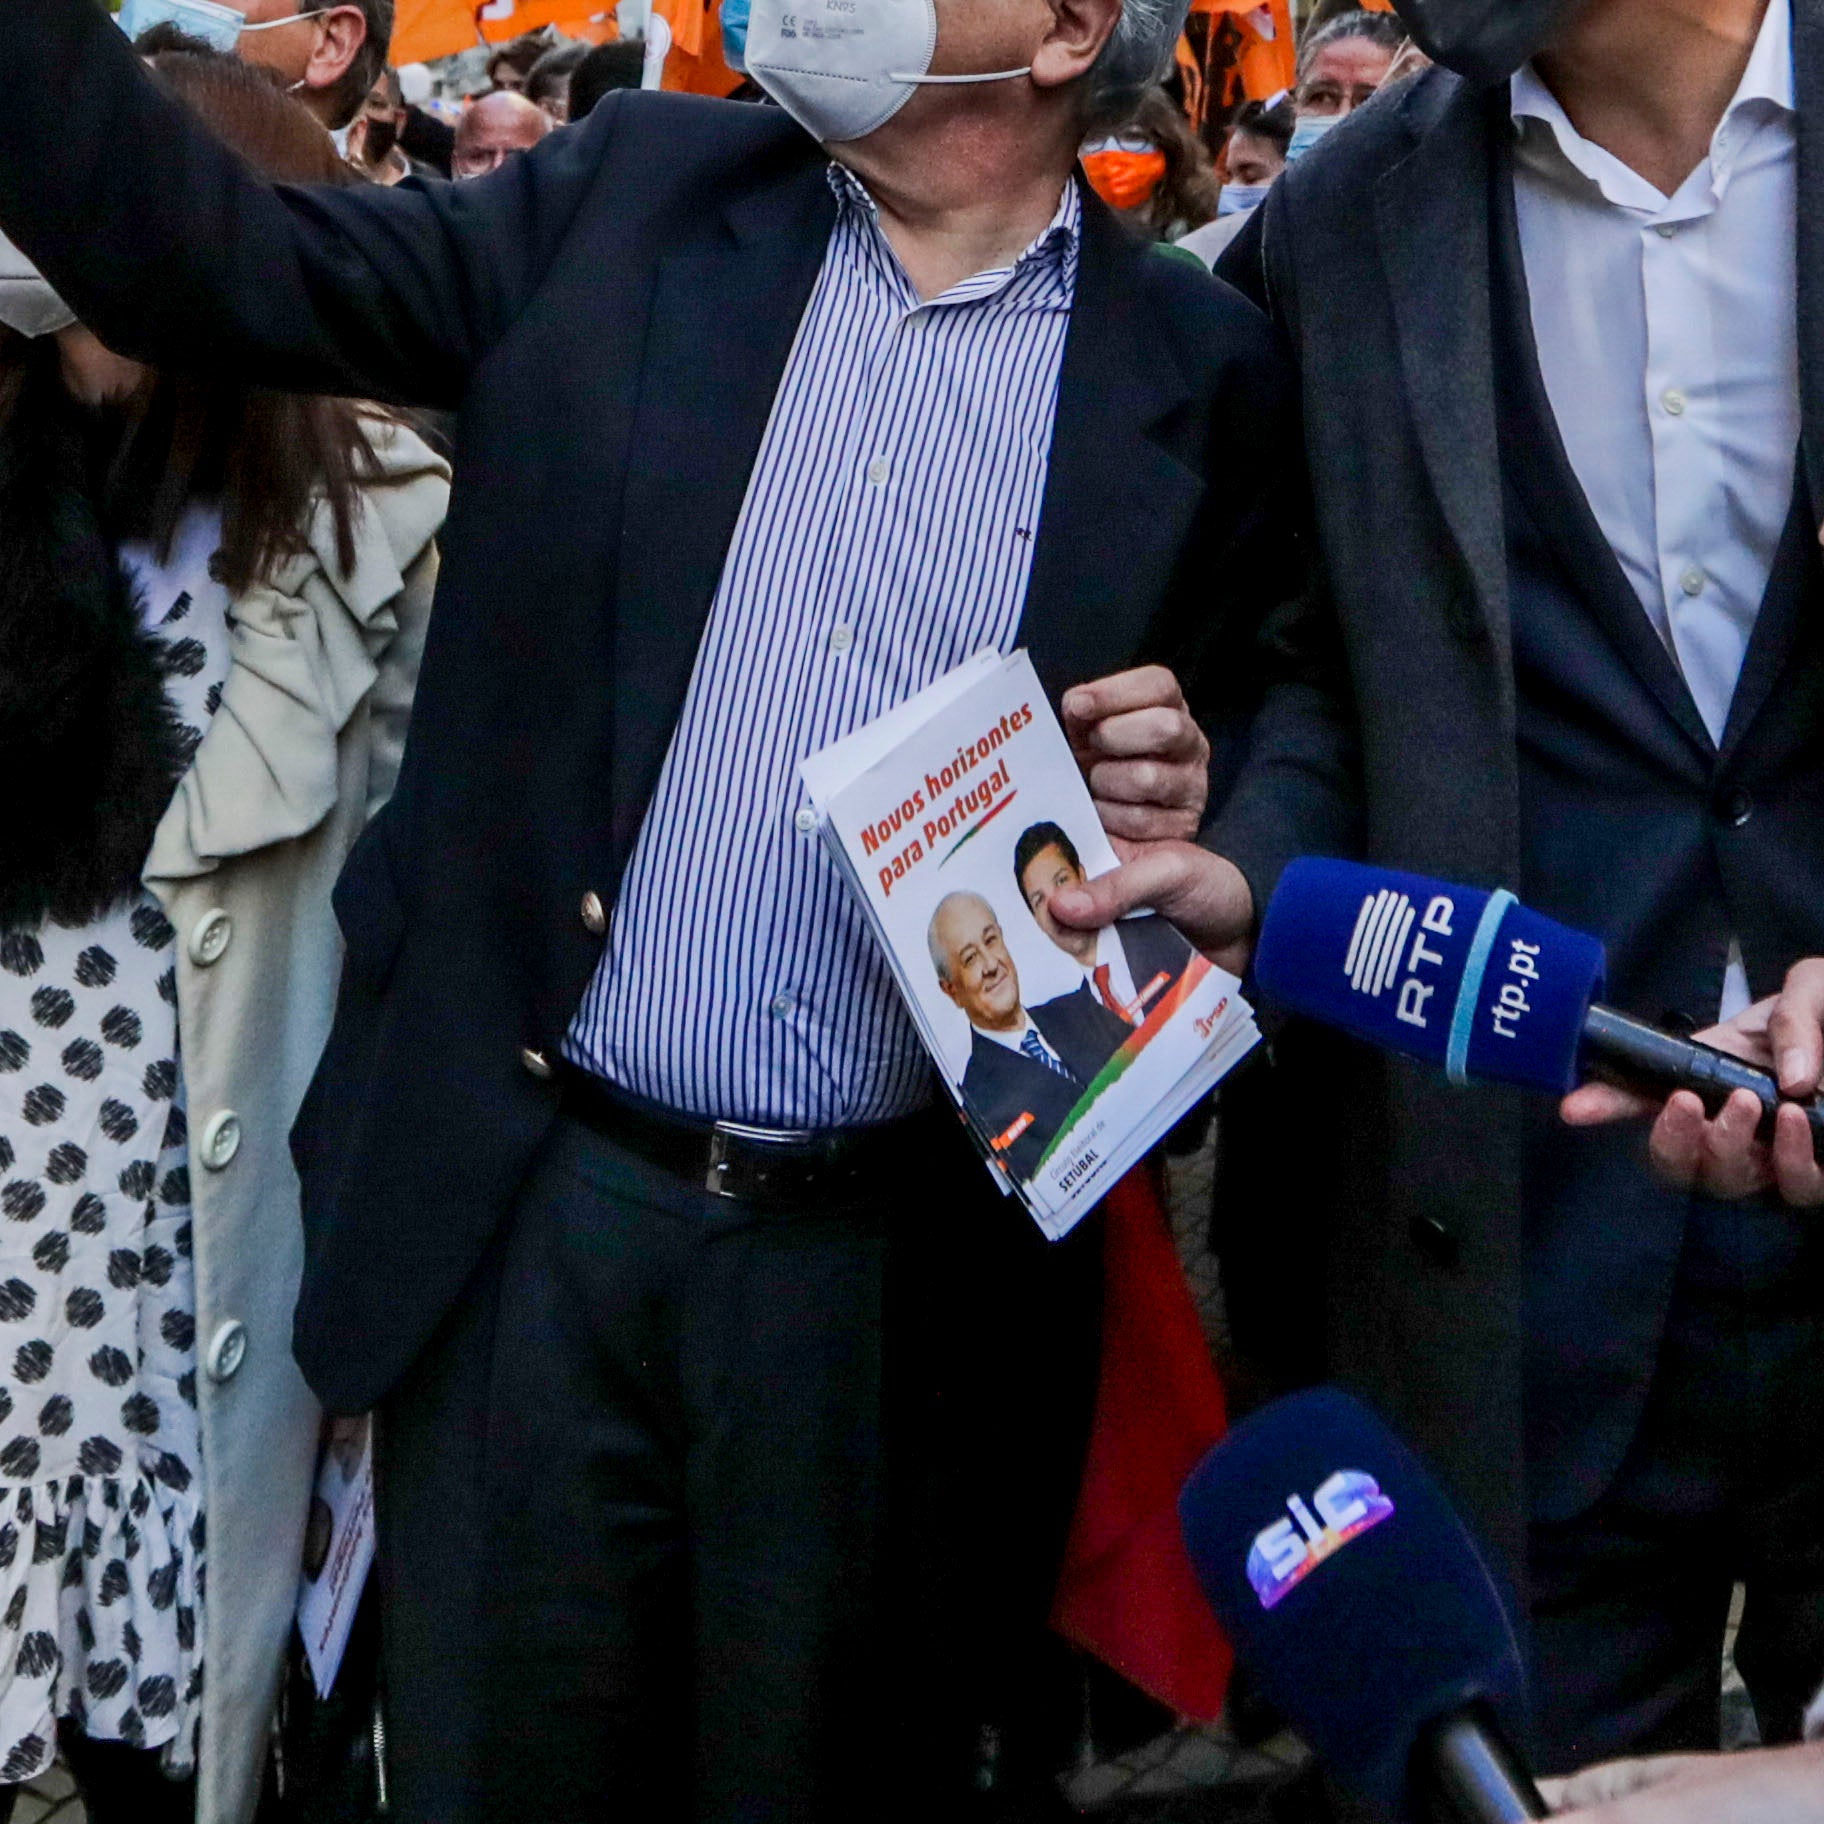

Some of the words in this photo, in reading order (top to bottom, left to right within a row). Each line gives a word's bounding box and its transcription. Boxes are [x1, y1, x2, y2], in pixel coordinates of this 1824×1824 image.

[859, 789, 926, 857] Novos
[924, 702, 1033, 802] horizontes
[878, 839, 925, 898] para
[922, 758, 1011, 850] Portugal
[1396, 895, 1455, 1029] RTP
[1491, 938, 1541, 1039] rtp.pt
[1058, 1149, 1100, 1193] SETÚBAL
